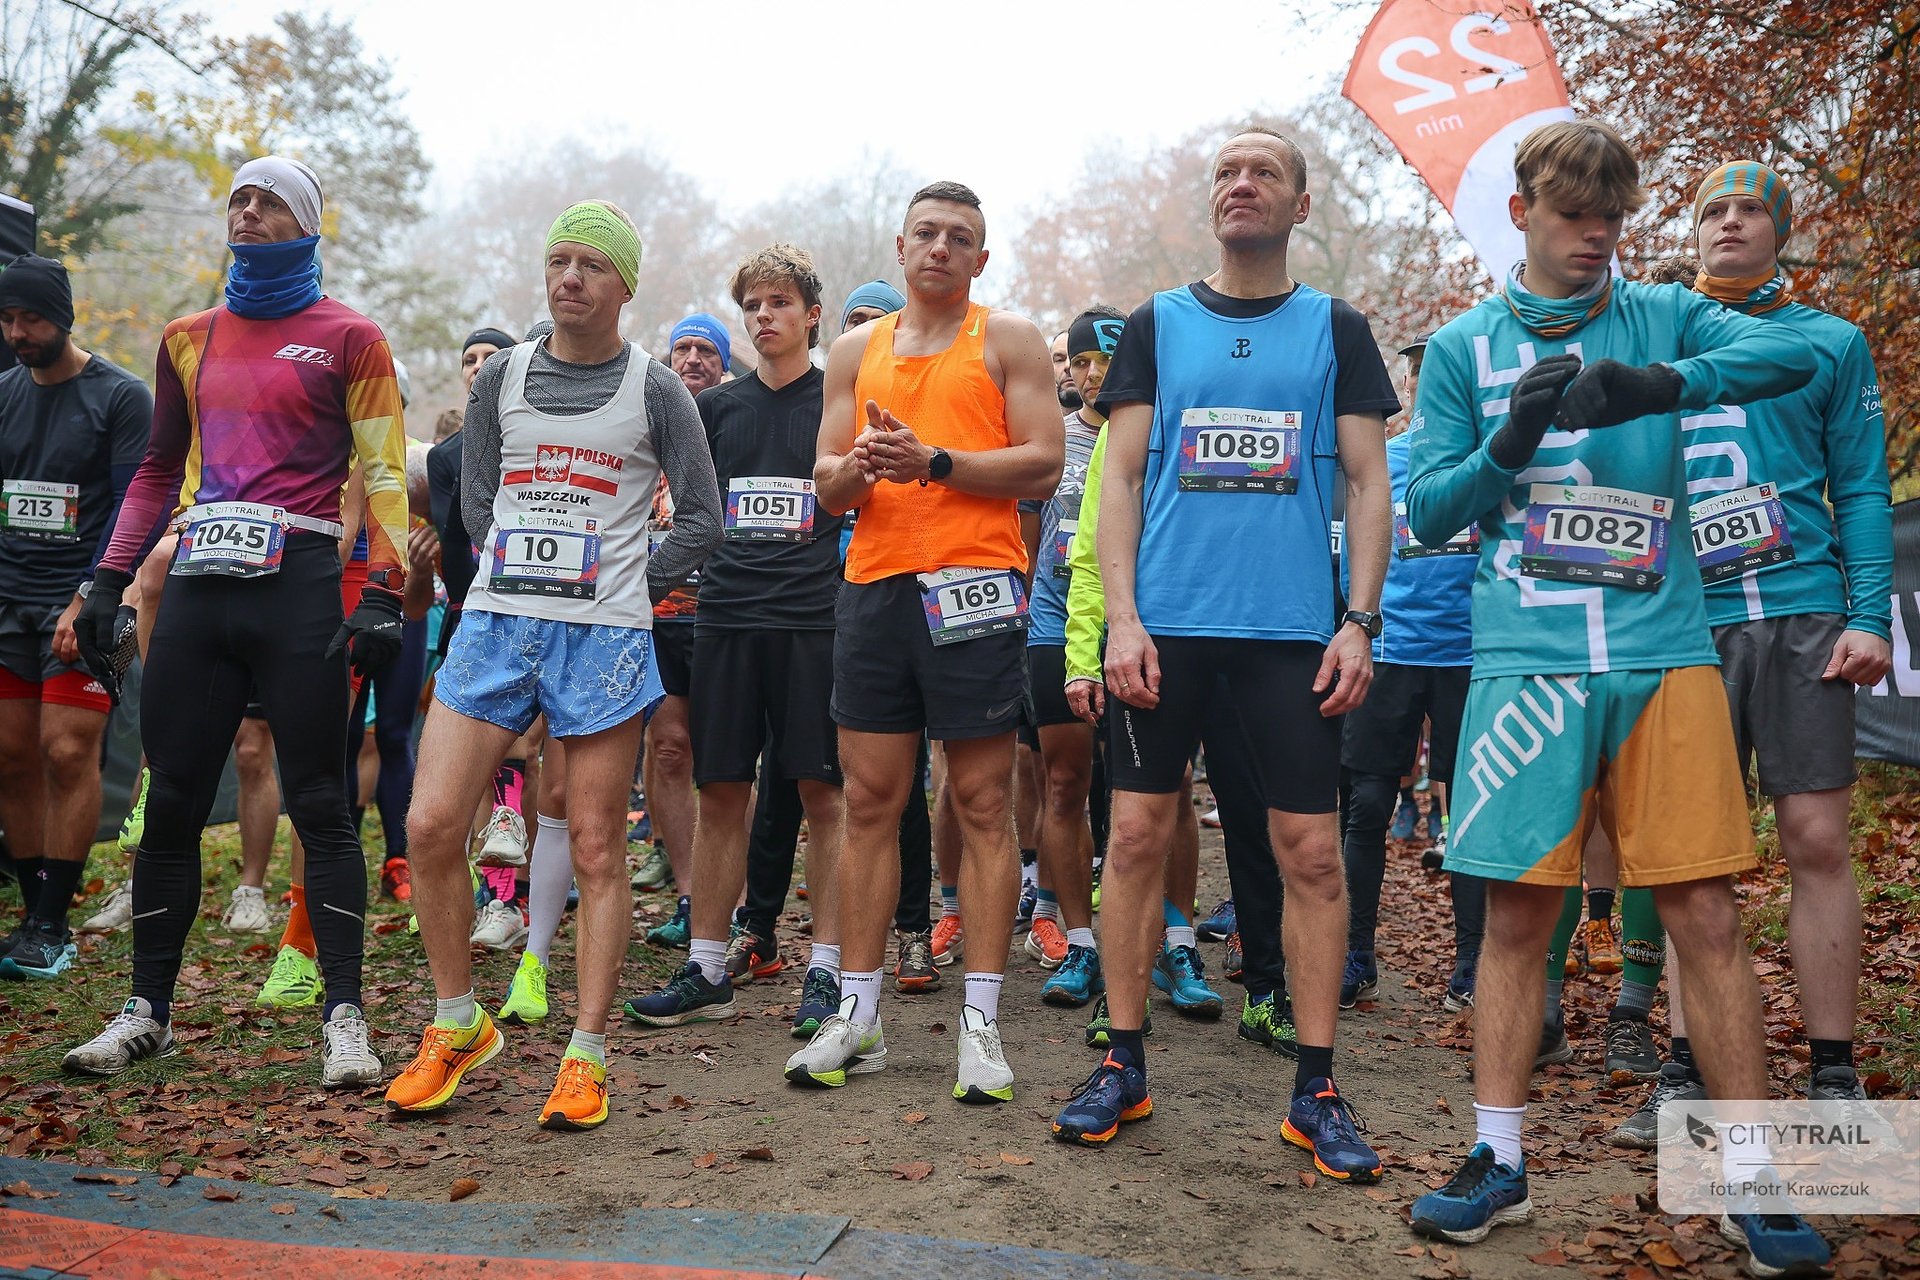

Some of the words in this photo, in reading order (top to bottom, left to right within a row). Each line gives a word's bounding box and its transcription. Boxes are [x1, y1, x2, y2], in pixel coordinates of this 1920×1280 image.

[574, 446, 625, 471] POLSKA
[1199, 432, 1280, 460] 1089
[17, 498, 53, 518] 213
[516, 490, 592, 507] WASZCZUK
[742, 496, 796, 517] 1051
[196, 522, 266, 549] 1045
[750, 519, 785, 527] MATEUSZ
[1550, 512, 1646, 550] 1082
[1691, 510, 1763, 553] 1081
[203, 549, 249, 561] WOJCIECH
[523, 535, 559, 563] 10
[520, 565, 559, 578] TOMASZ
[949, 580, 1001, 611] 169
[965, 610, 1000, 623] MICHAŁ
[1124, 710, 1142, 768] ENDURANCE
